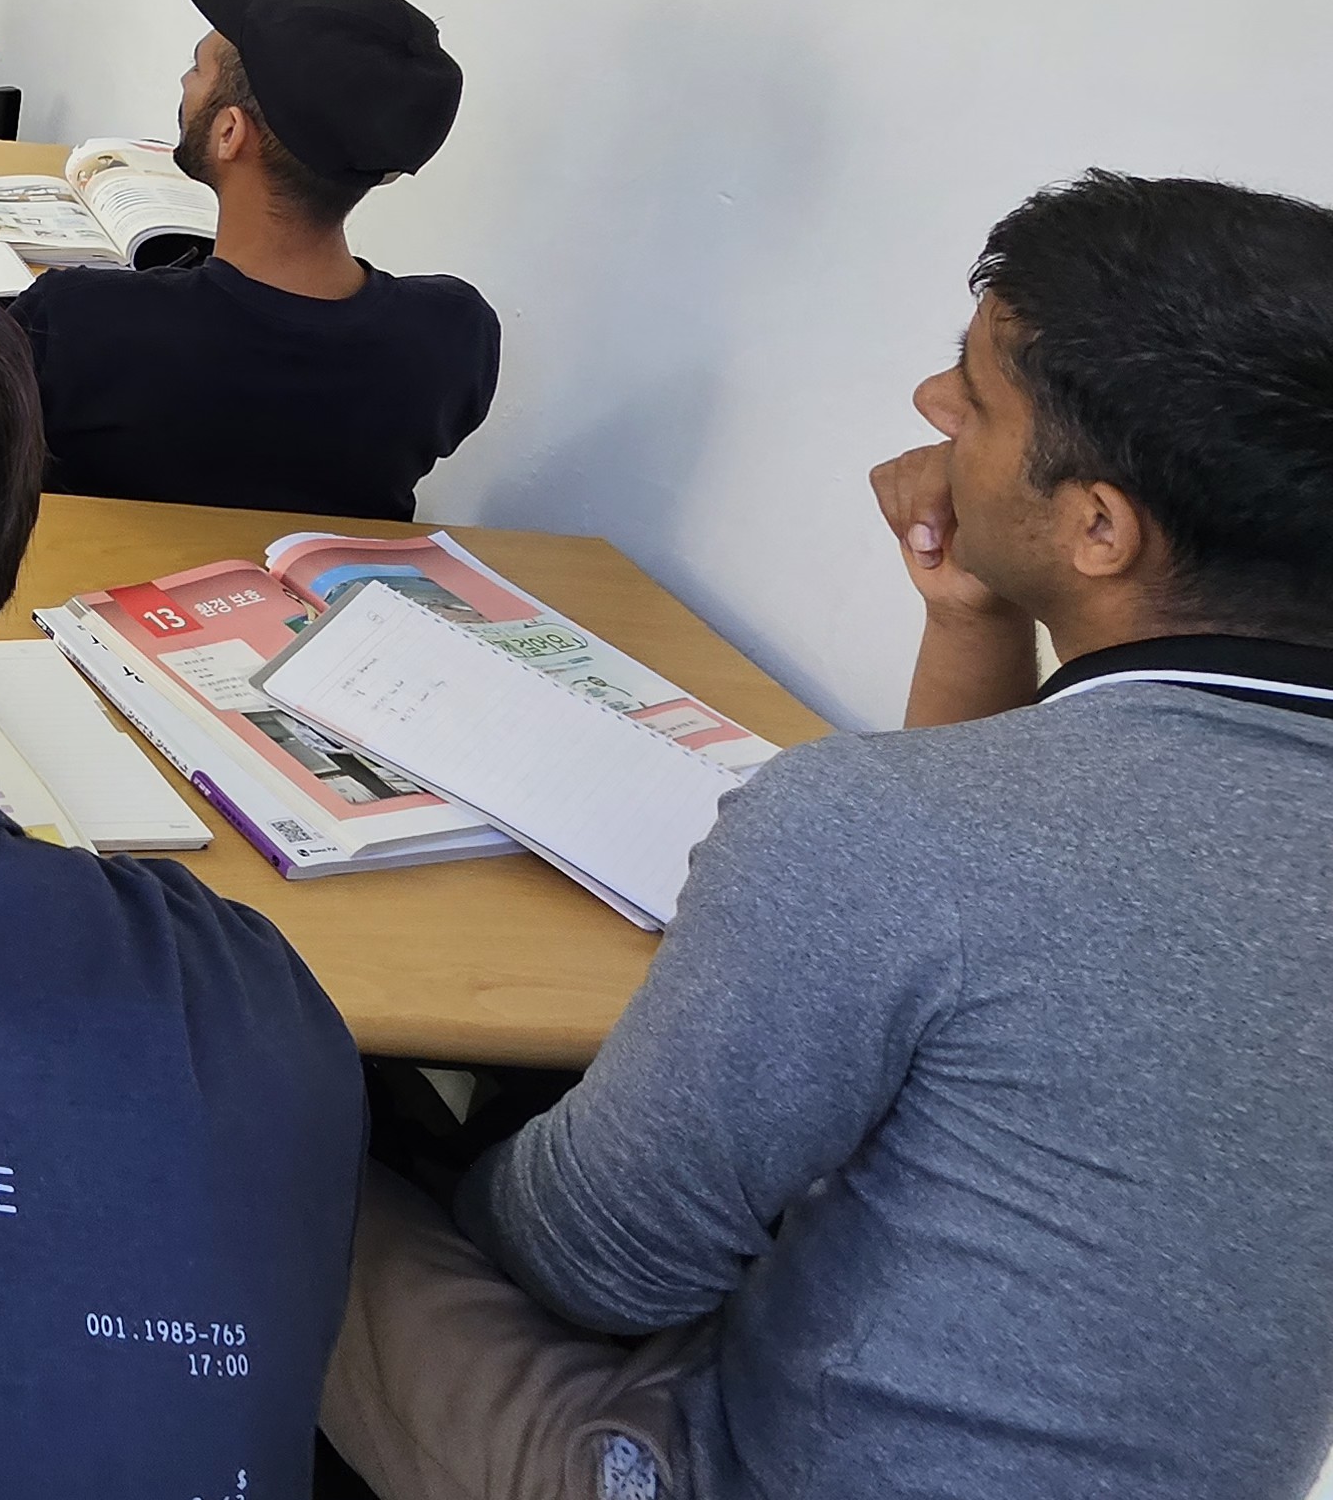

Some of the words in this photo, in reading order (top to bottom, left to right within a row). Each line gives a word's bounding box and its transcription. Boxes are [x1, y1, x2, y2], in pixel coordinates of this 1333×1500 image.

[194, 598, 233, 618] 환경
[228, 589, 267, 608] 보호
[143, 607, 187, 631] 13
[86, 1313, 246, 1346] 001.1985-765
[188, 1353, 248, 1377] 17:00
[236, 1469, 248, 1490] $
